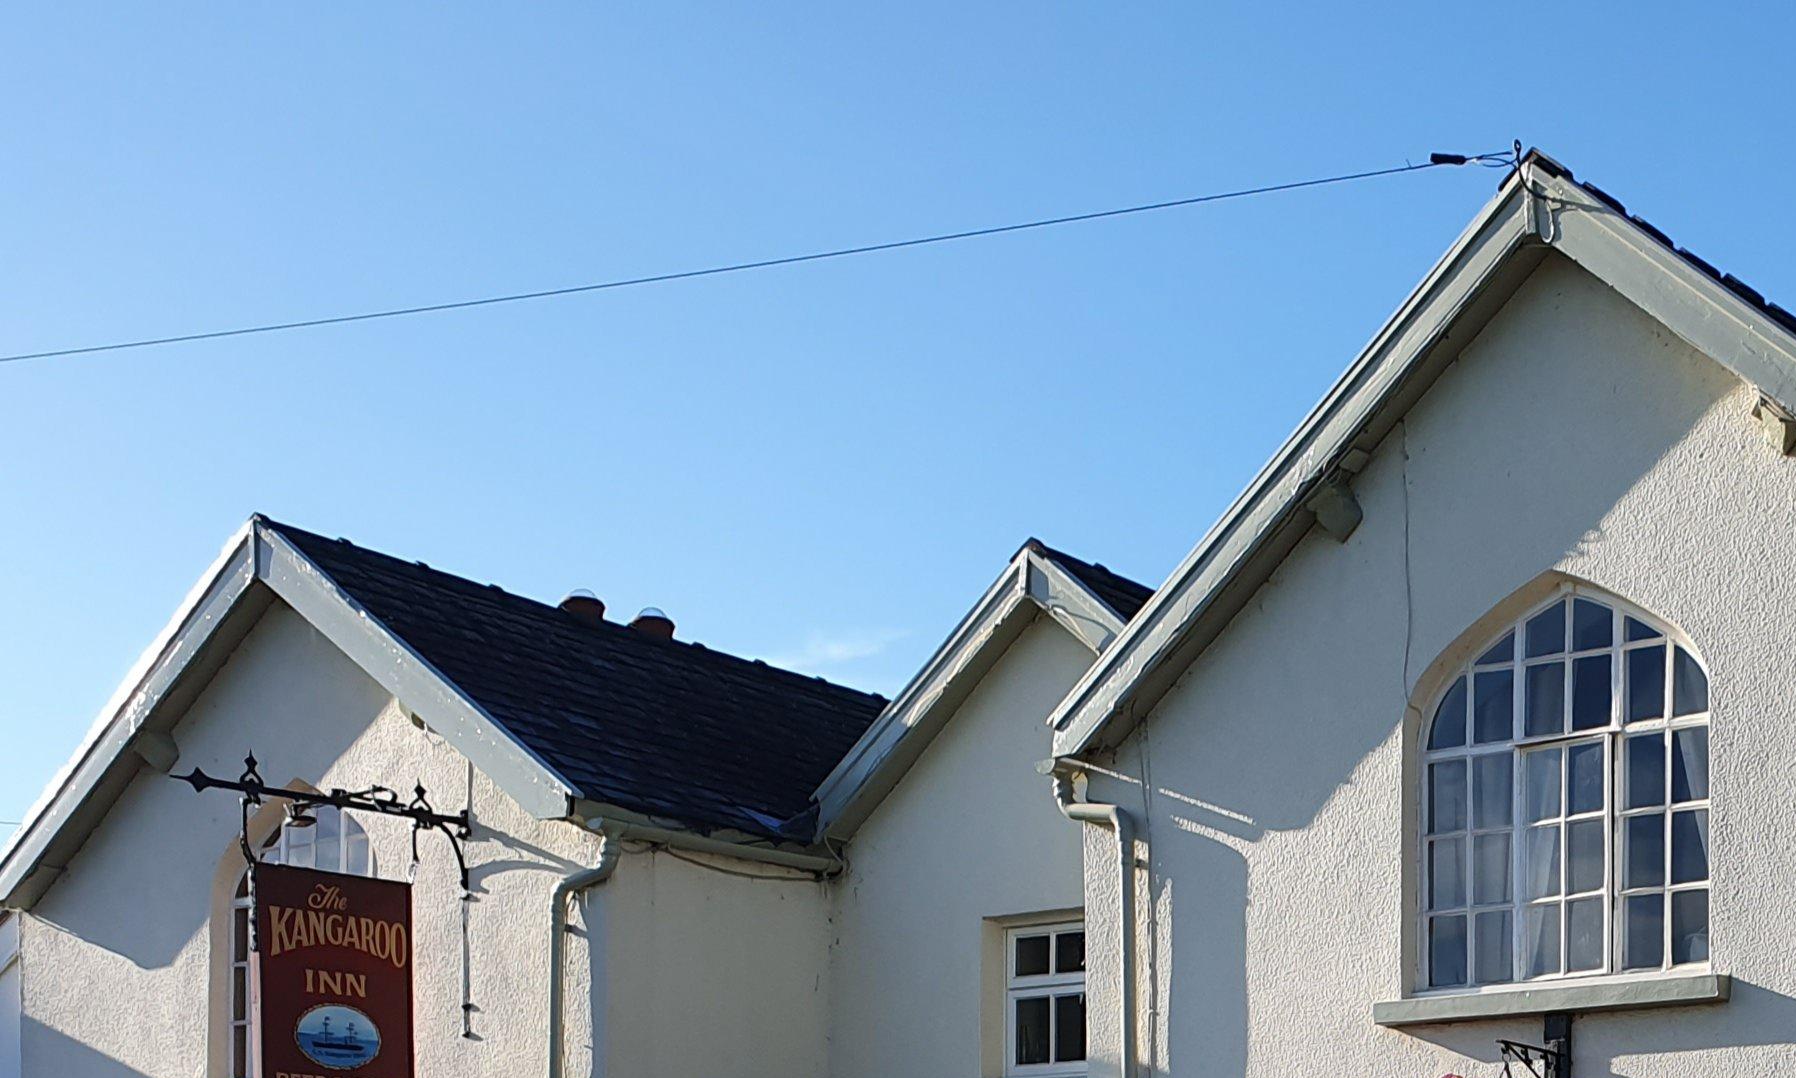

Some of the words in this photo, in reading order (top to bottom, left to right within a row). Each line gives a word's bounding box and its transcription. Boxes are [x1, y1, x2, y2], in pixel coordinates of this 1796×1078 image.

[308, 884, 347, 911] The
[269, 906, 407, 968] KANGAROO
[305, 969, 367, 997] INN
